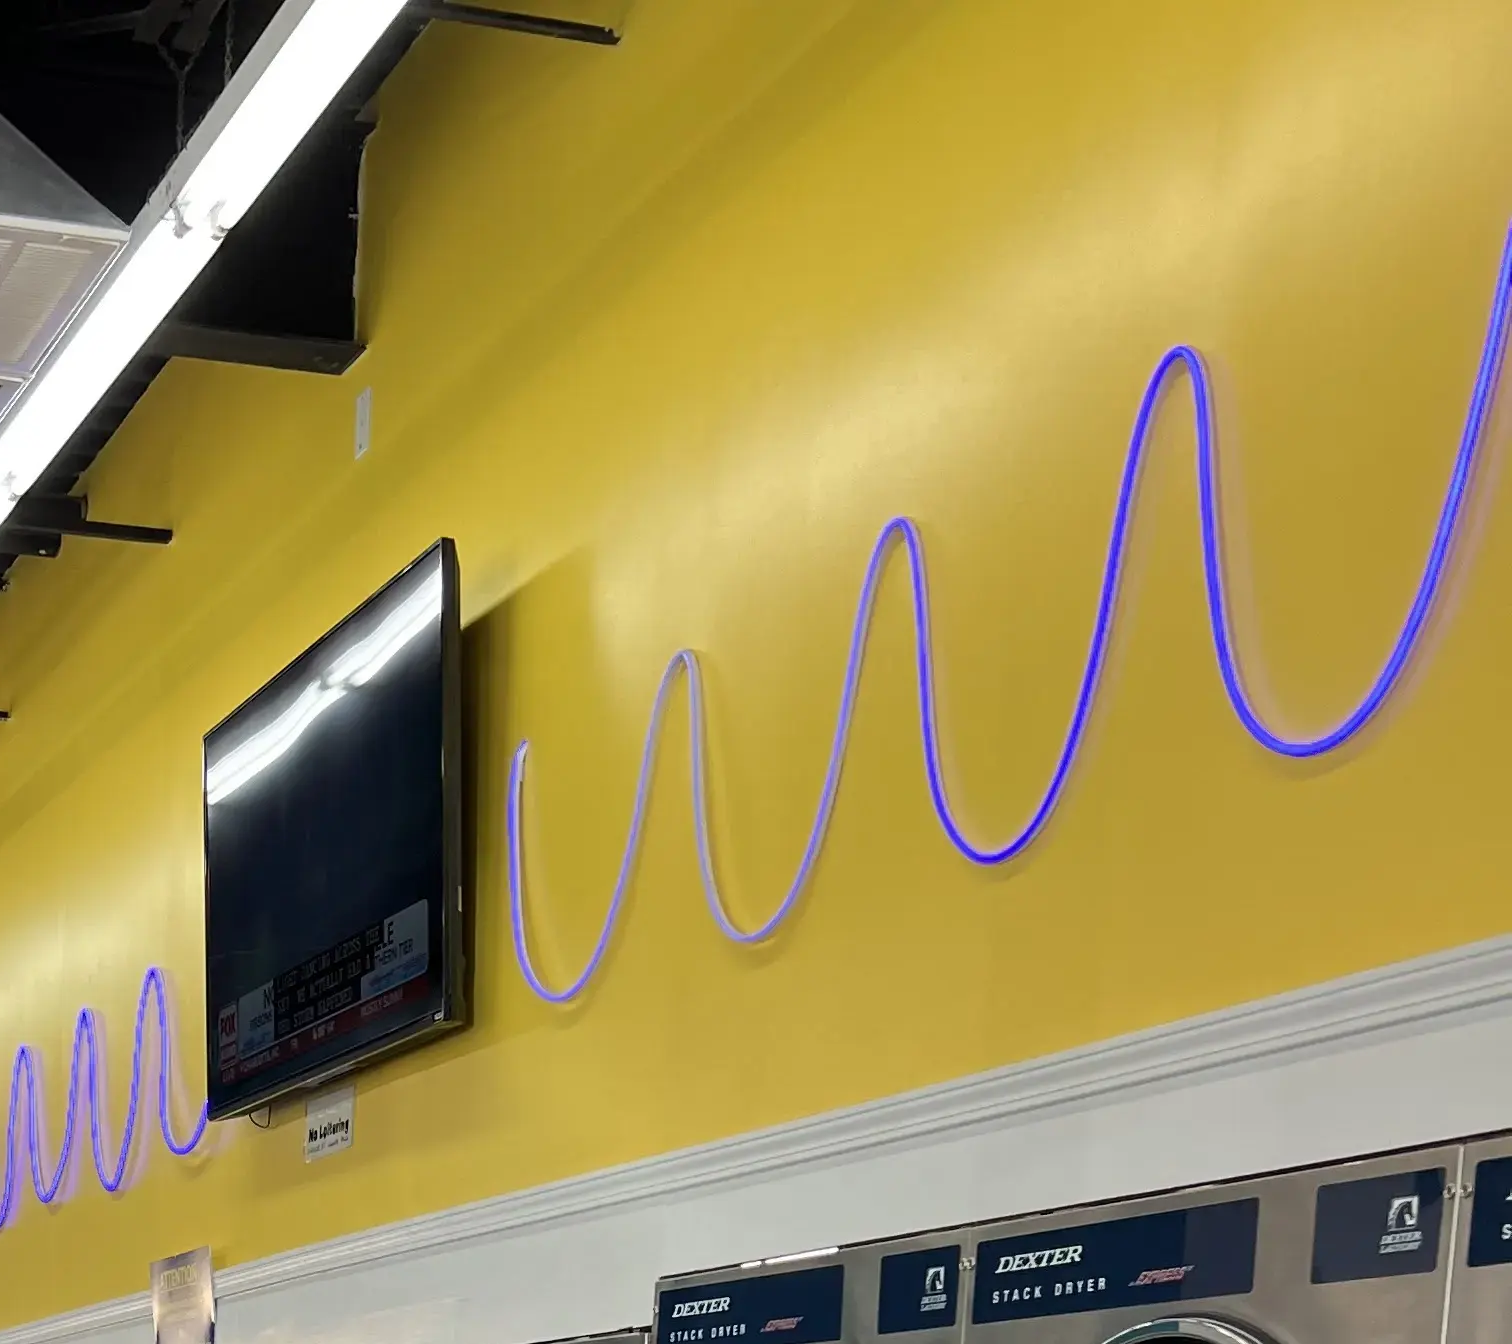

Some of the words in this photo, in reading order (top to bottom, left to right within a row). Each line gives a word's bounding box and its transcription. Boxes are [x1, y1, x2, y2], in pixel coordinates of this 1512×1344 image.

[220, 1012, 236, 1035] FOX
[308, 1128, 318, 1143] No
[319, 1117, 350, 1140] Loitering
[994, 1245, 1083, 1274] DEXTER
[992, 1285, 1042, 1304] STACK
[1054, 1277, 1107, 1296] DRYER
[672, 1296, 730, 1318] DEXTER
[669, 1328, 704, 1343] STACK
[711, 1323, 746, 1339] DRYER
